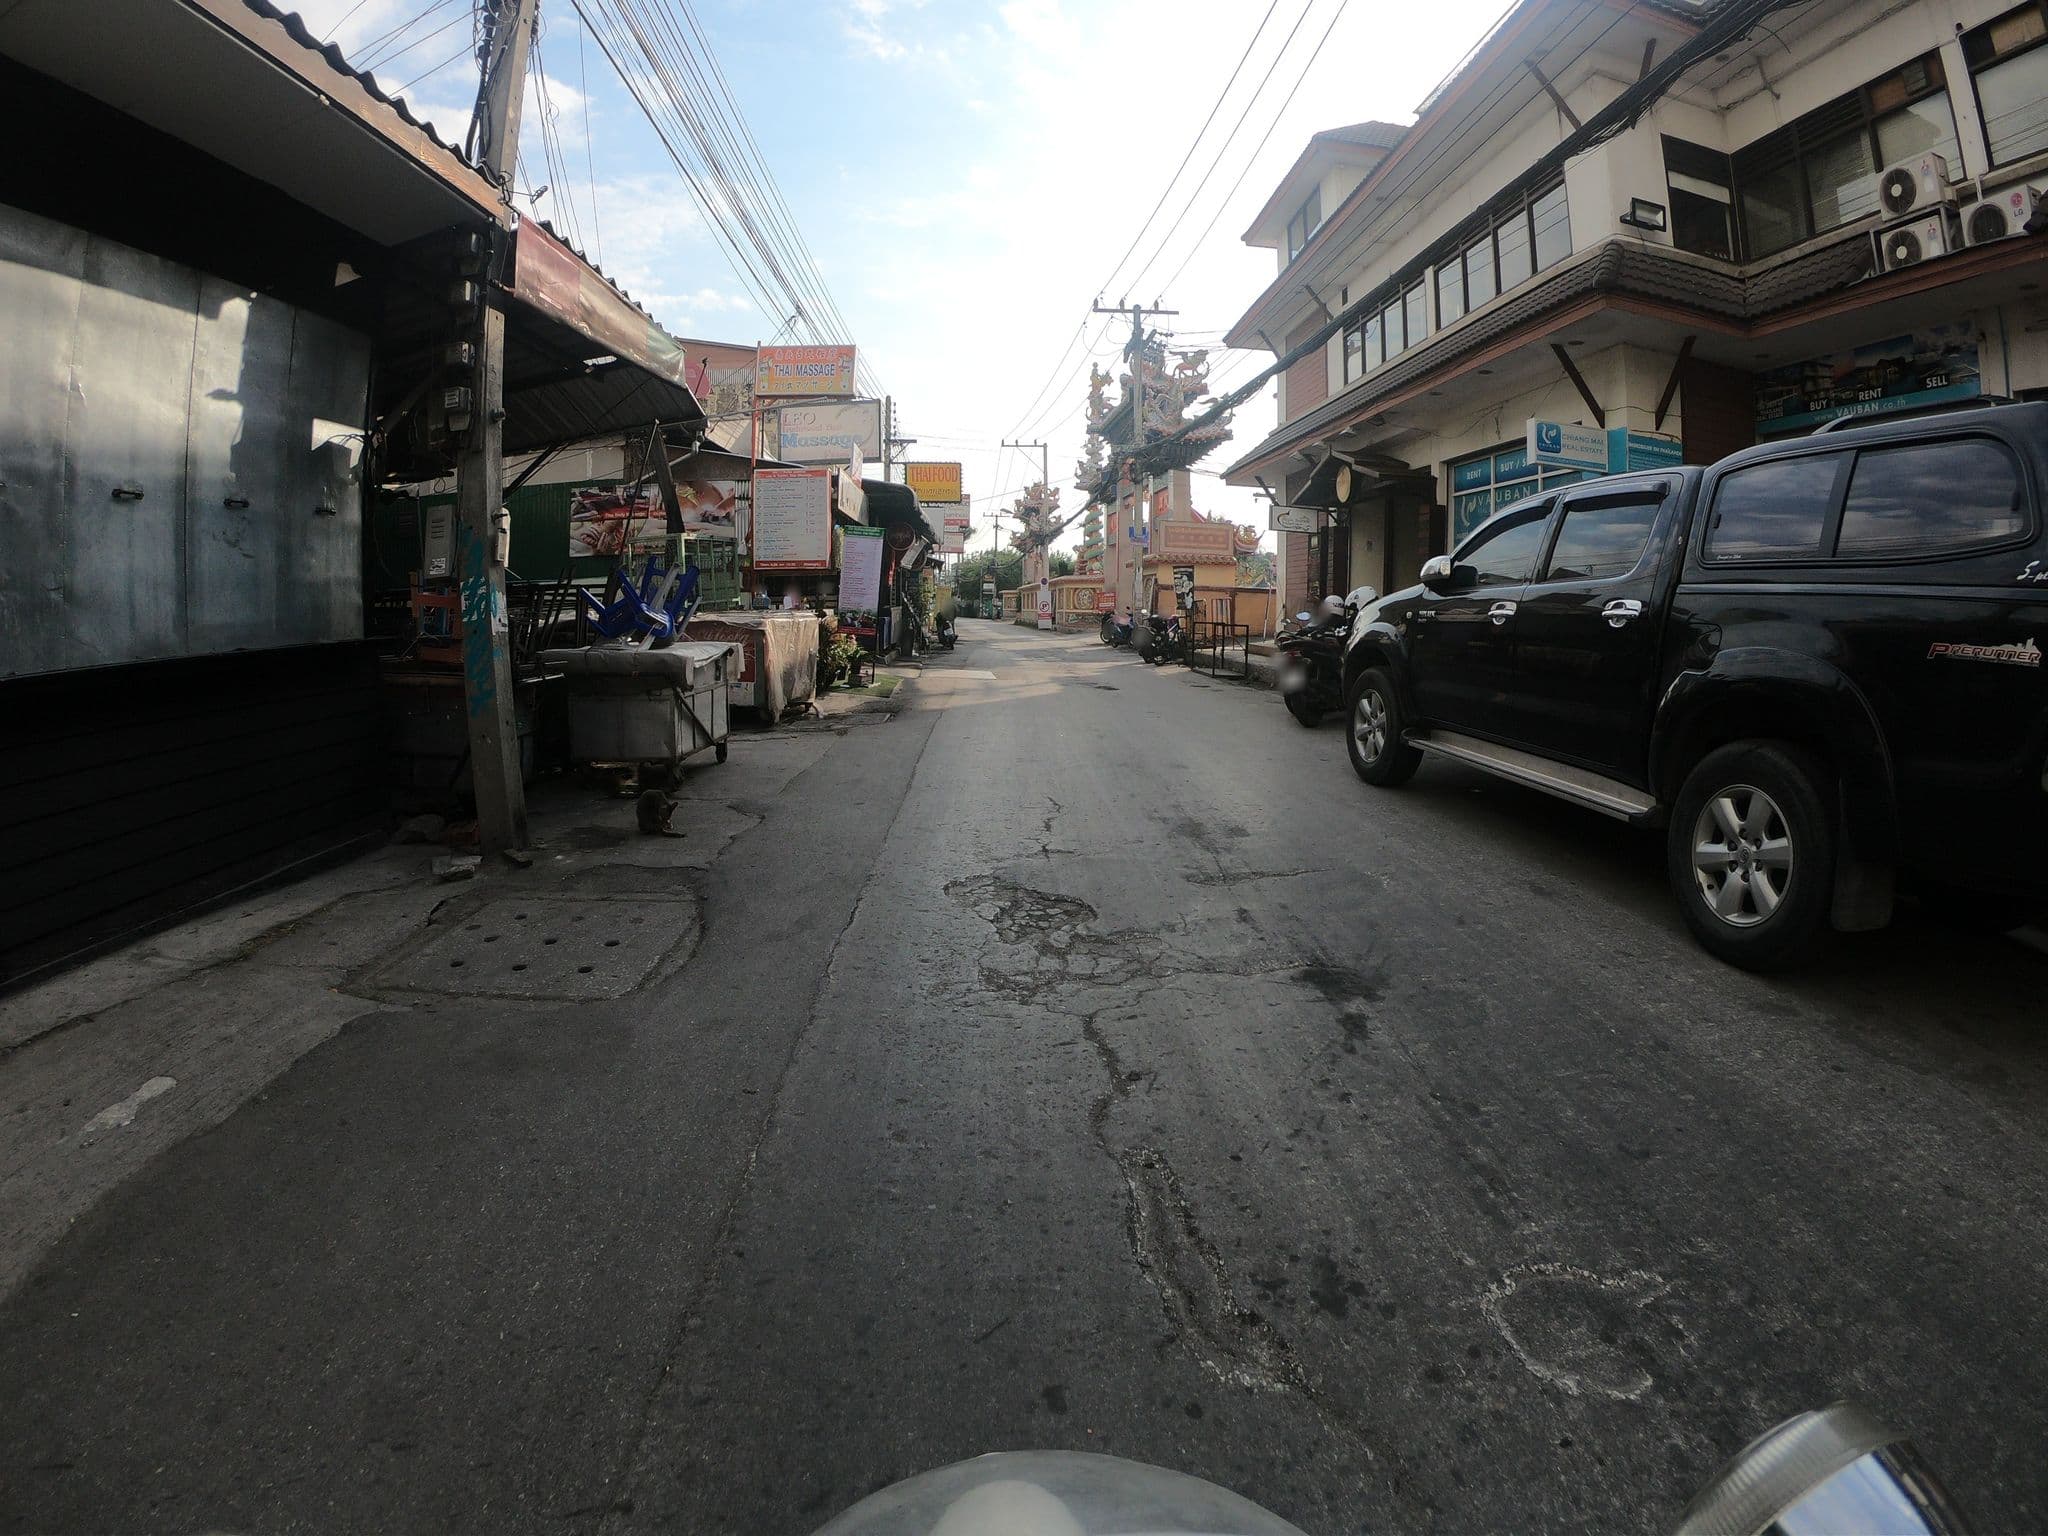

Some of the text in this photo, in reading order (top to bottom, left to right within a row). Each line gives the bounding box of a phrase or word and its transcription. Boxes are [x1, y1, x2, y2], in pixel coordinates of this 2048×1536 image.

[2013, 208, 2024, 217] LG
[774, 364, 836, 377] THAI MASSAGE
[1926, 376, 1948, 388] SELL
[1858, 388, 1882, 401] RENT
[1809, 399, 1828, 411] BUY
[1562, 434, 1603, 446] CHIANG MAI
[1562, 444, 1603, 455] REAL ESTATE
[1500, 461, 1514, 472] BUY
[910, 466, 958, 482] THAI FOOD
[1466, 469, 1481, 480] RENT
[1478, 486, 1531, 506] VAUBAN
